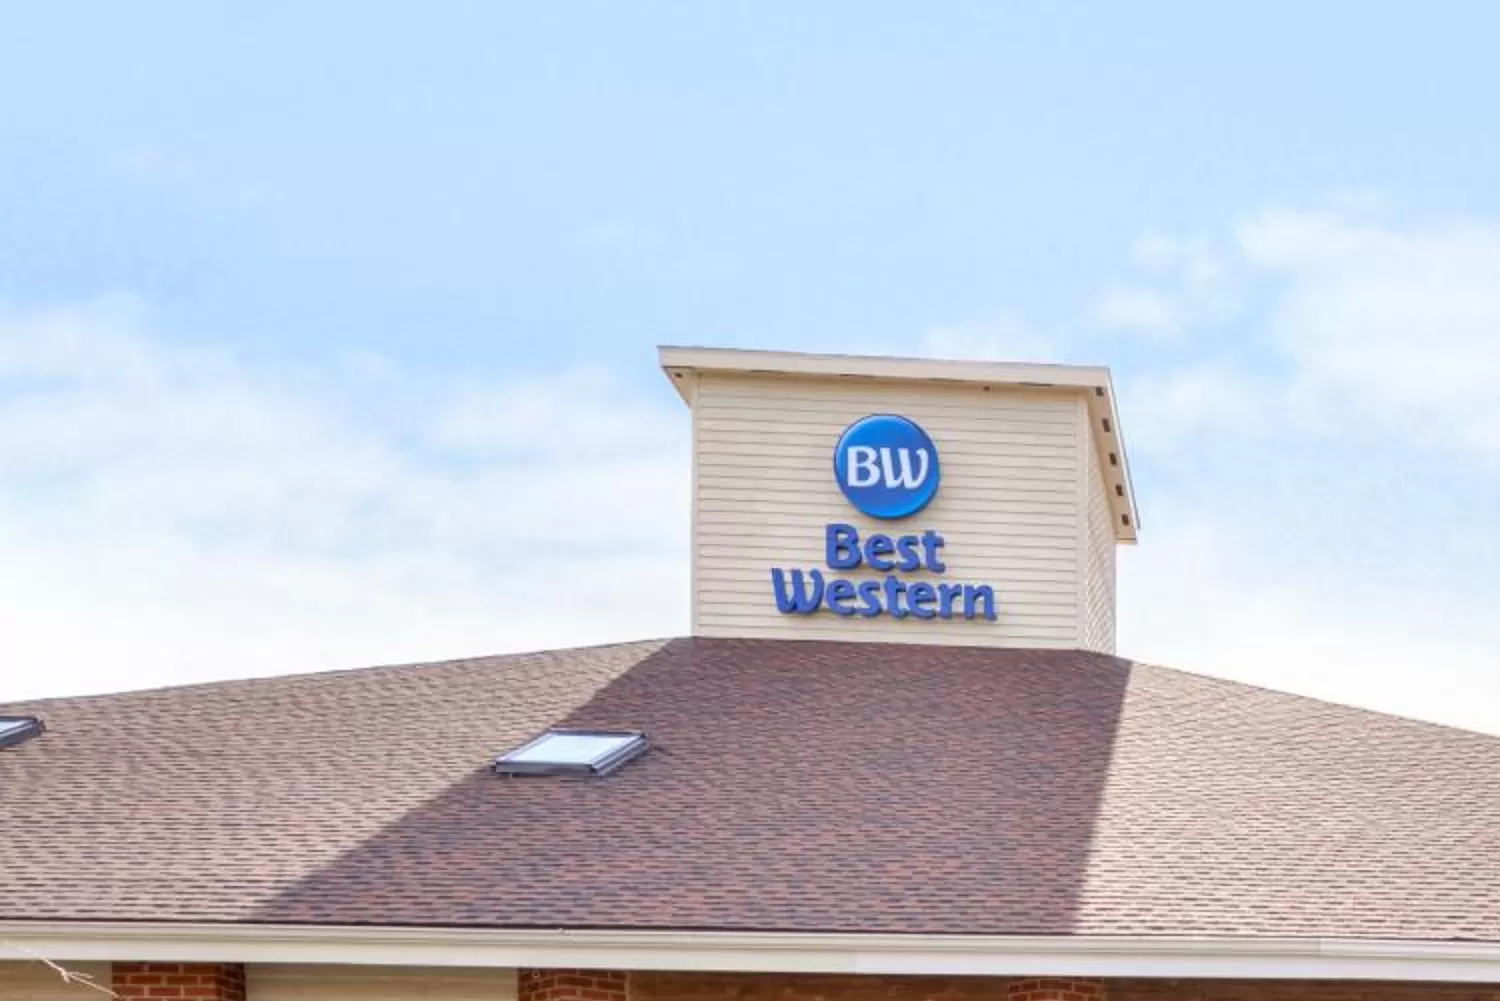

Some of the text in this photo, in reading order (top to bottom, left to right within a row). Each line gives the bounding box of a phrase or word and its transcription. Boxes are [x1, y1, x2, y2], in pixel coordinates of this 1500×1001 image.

[846, 446, 929, 489] BW
[825, 523, 946, 573] Best
[771, 567, 998, 621] Western
